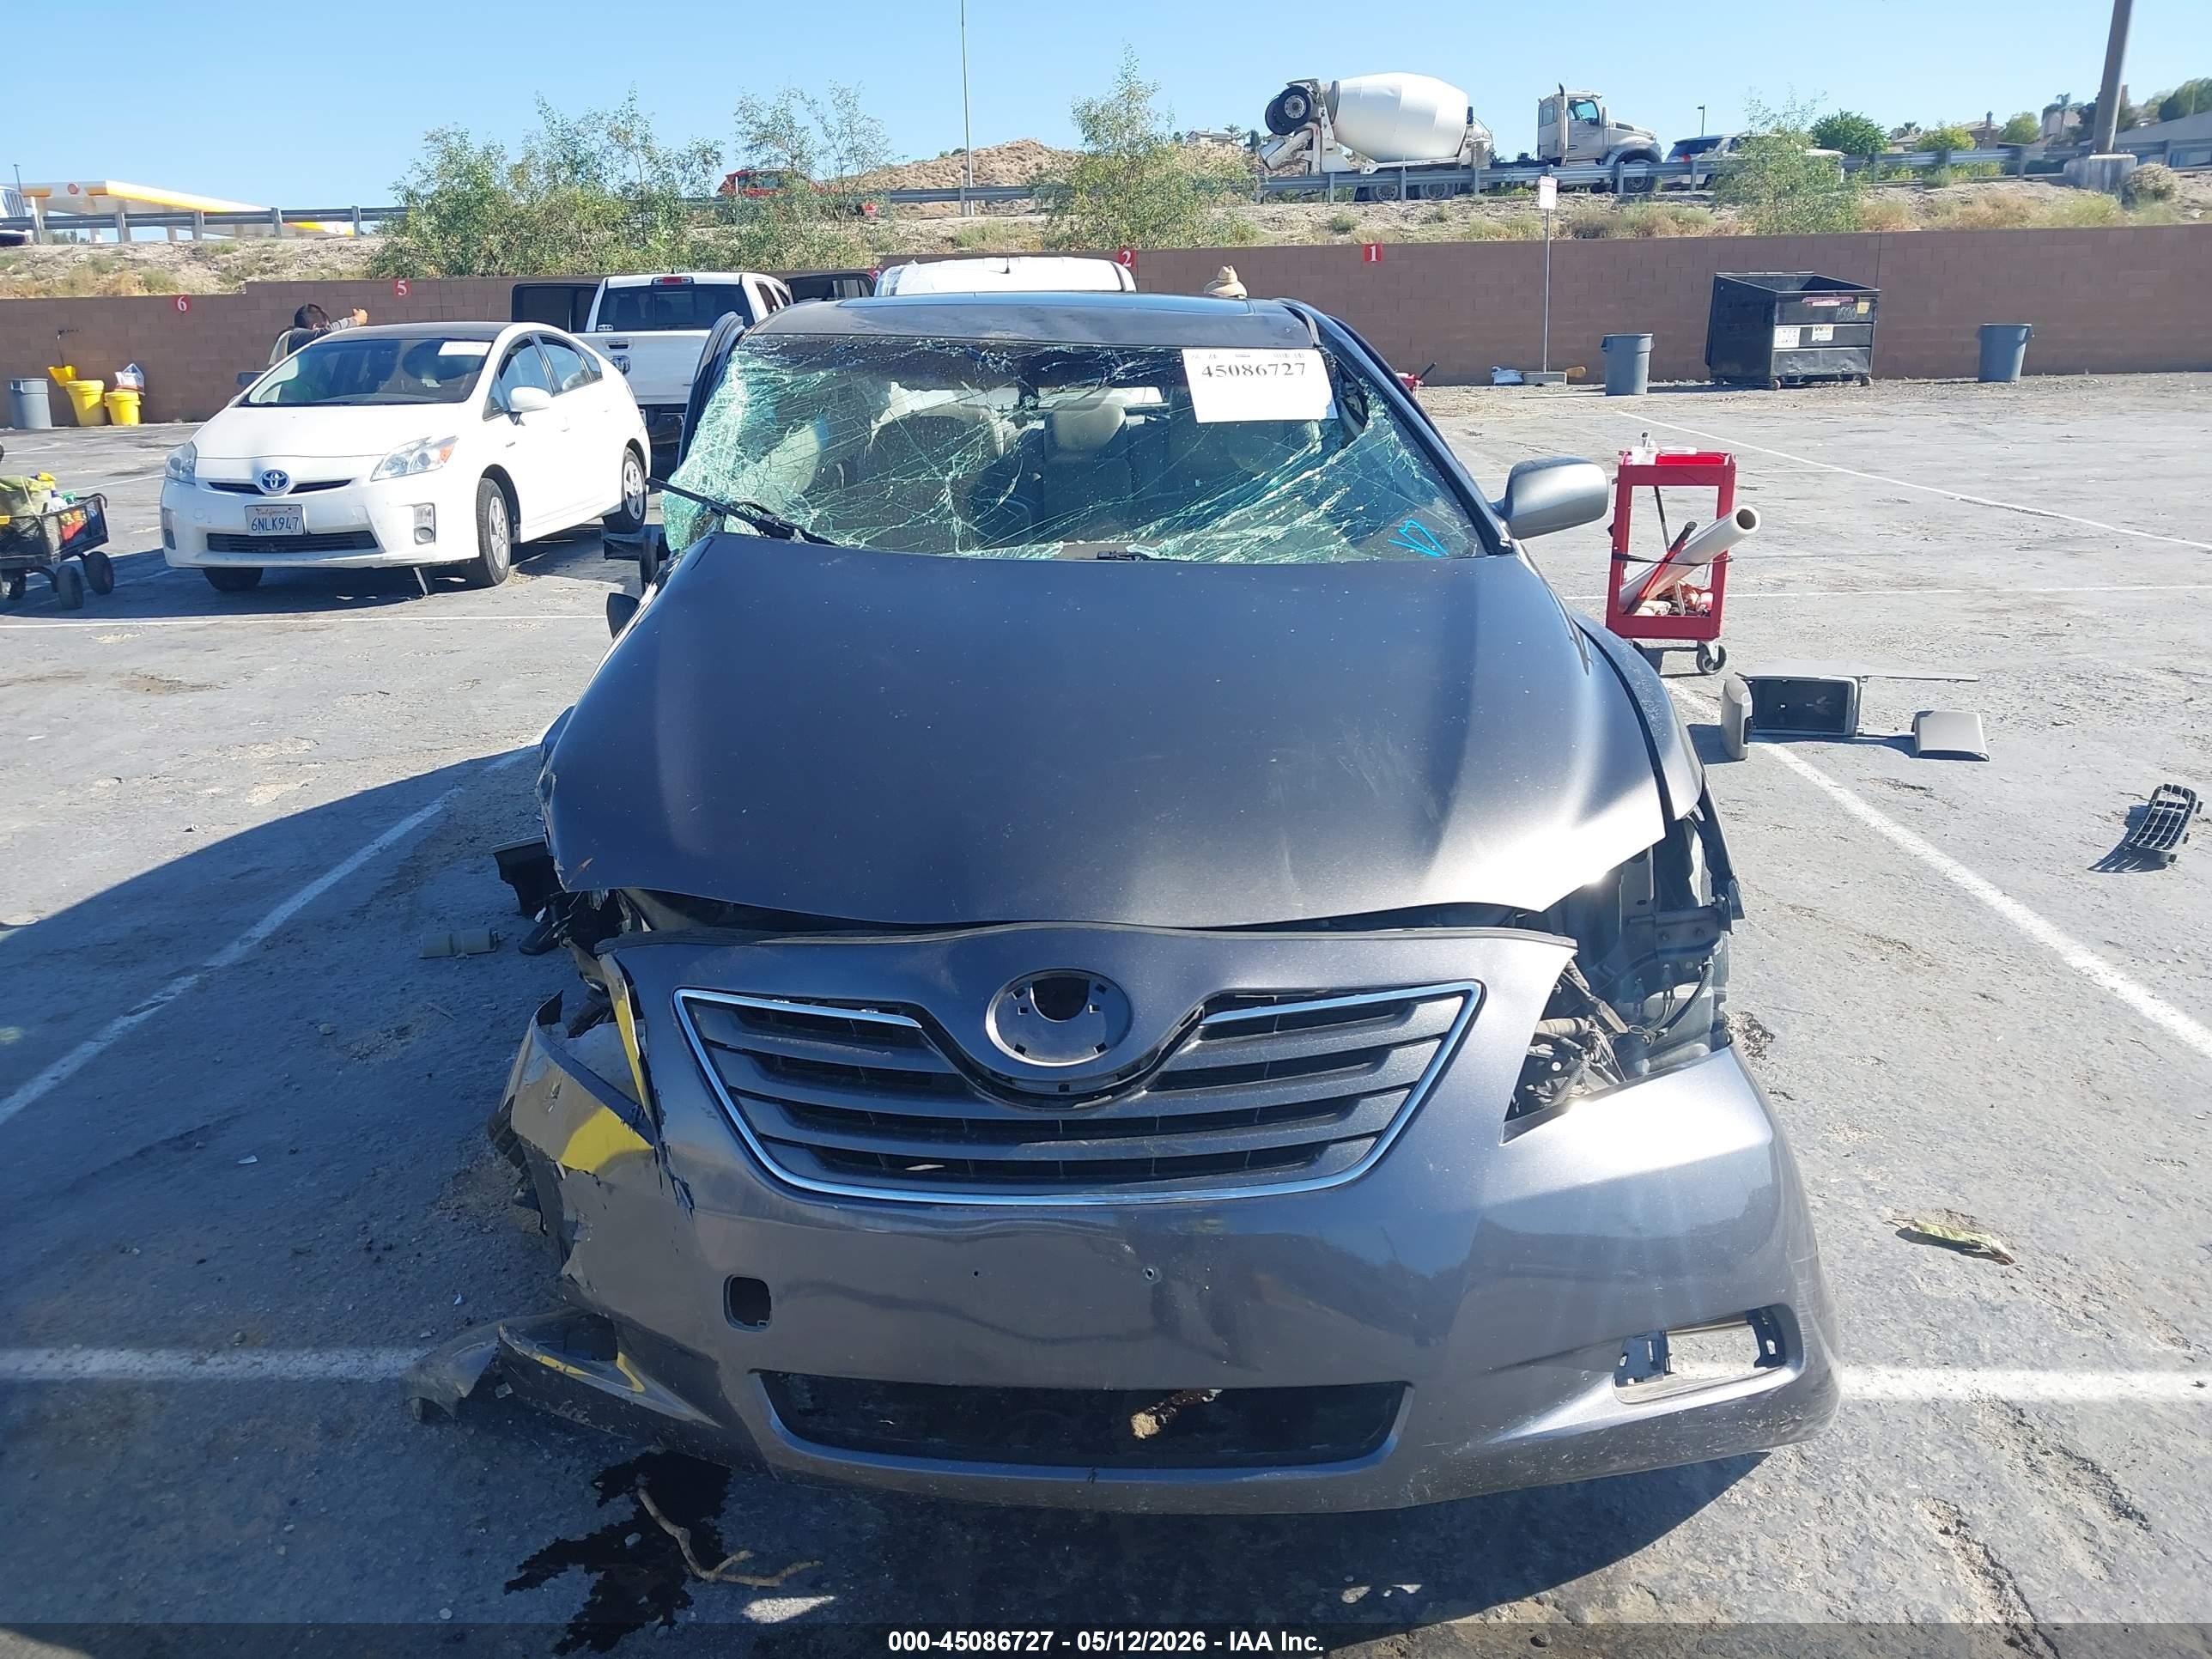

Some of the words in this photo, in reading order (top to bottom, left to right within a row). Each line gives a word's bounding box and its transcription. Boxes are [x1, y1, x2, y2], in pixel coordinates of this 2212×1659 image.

[1121, 250, 1132, 267] 2
[1369, 245, 1378, 262] 1
[398, 280, 407, 296] 5
[177, 295, 187, 312] 6
[1201, 362, 1306, 378] 45086727
[251, 517, 299, 532] 6NLK947
